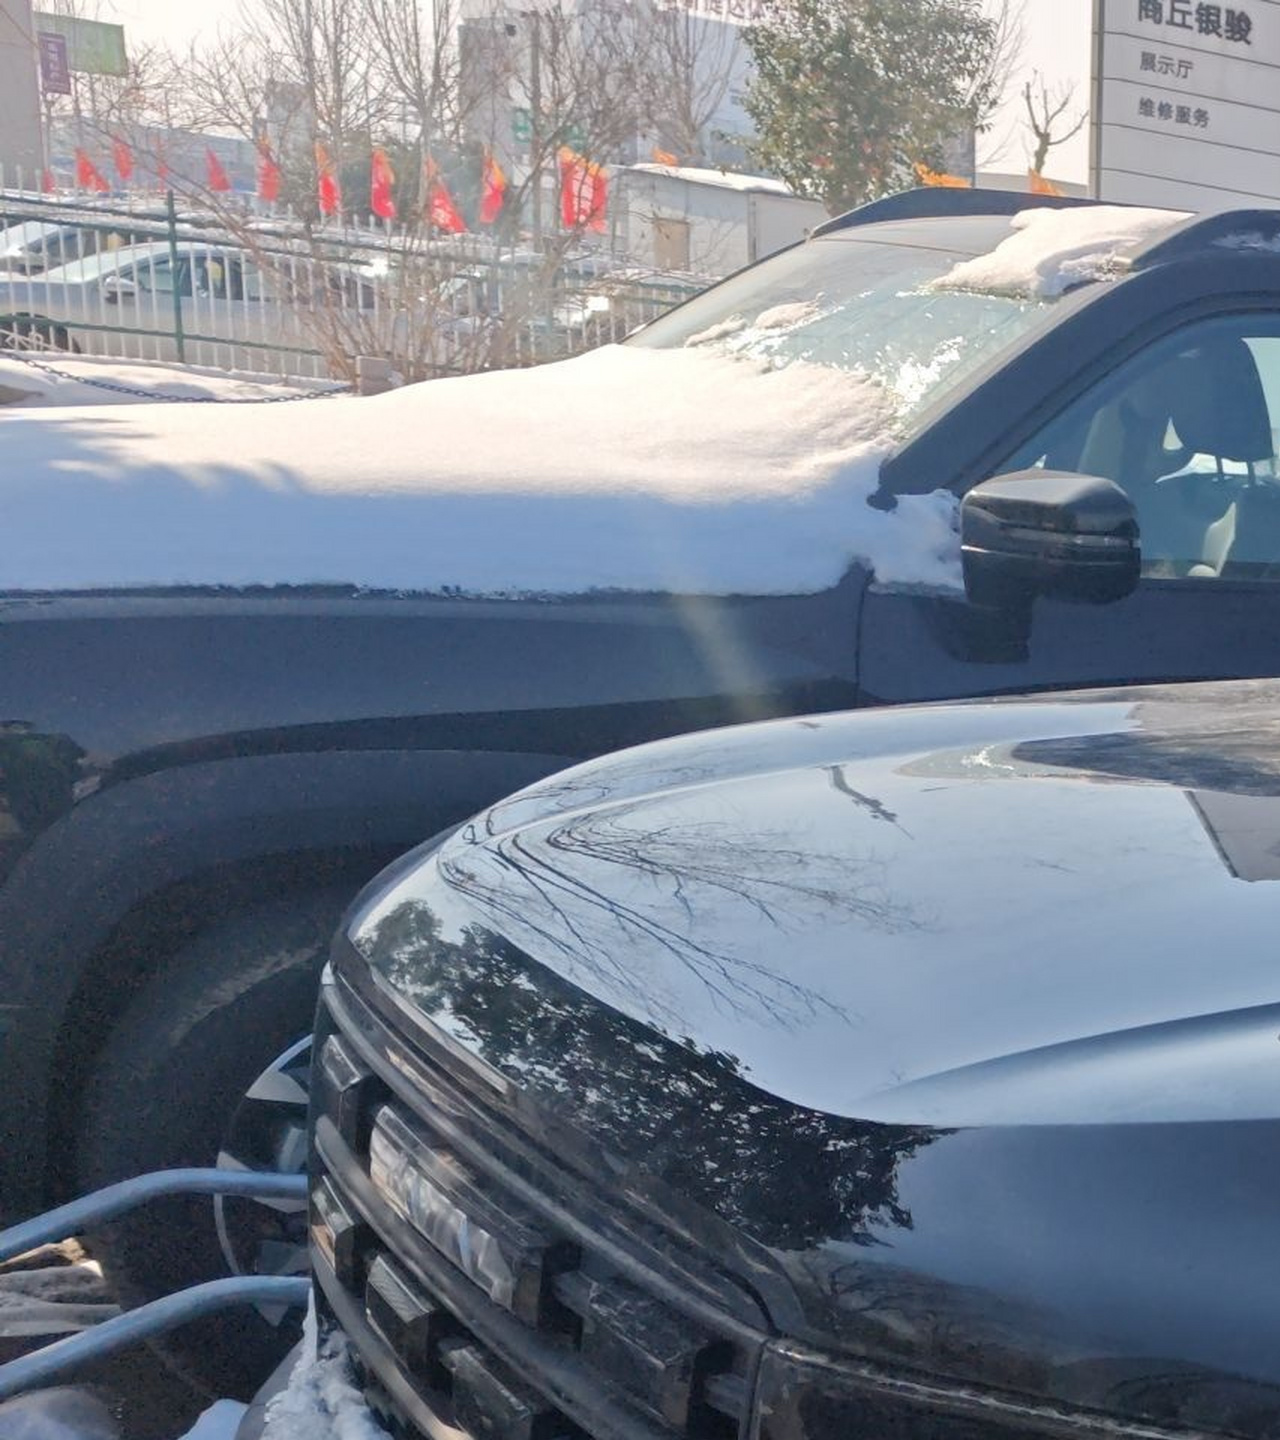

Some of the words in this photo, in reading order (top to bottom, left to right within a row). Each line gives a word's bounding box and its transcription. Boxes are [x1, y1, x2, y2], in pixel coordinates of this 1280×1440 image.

[1140, 52, 1193, 79] 展示厅
[1138, 98, 1210, 129] 维修服务
